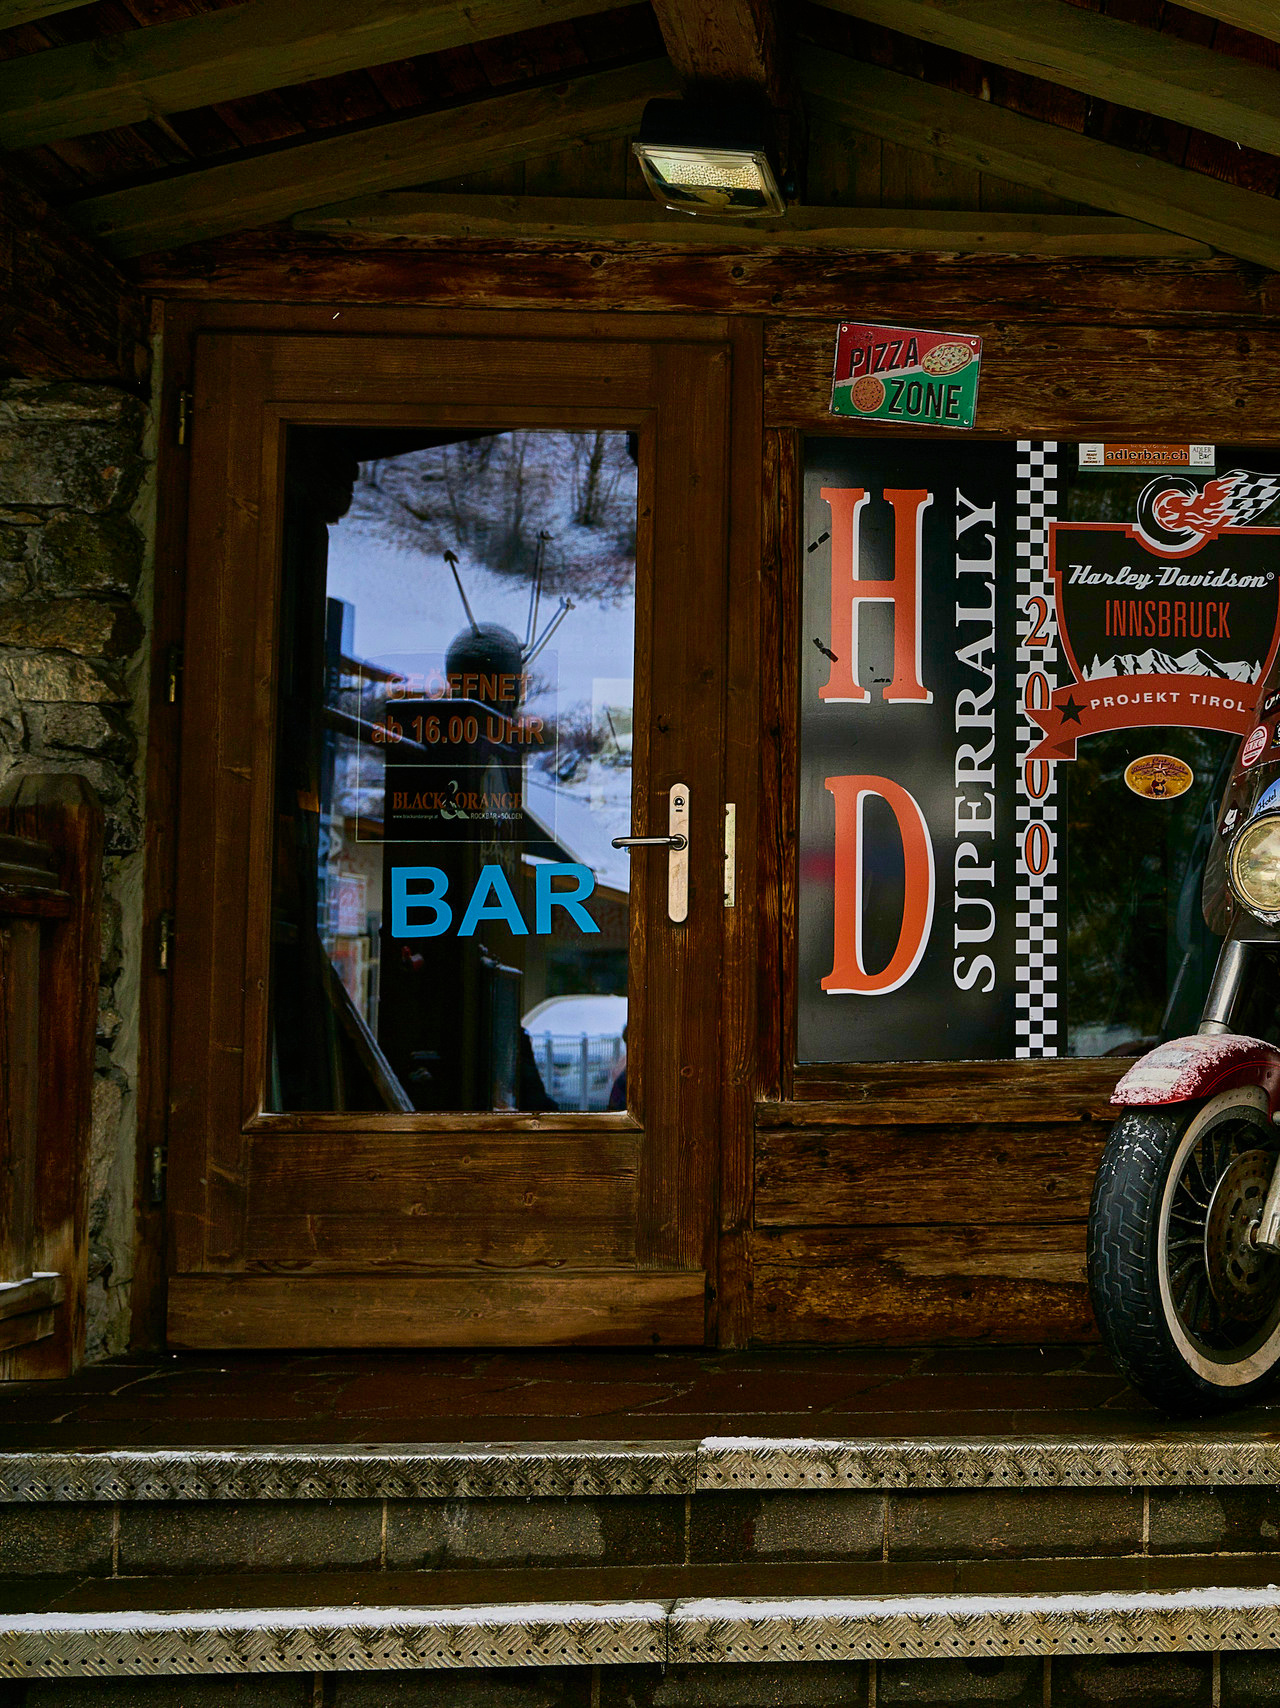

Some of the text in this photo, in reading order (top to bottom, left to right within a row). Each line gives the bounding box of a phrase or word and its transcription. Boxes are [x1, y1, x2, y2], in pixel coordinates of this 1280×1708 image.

[849, 337, 921, 378] PIZZA
[888, 378, 963, 420] ZONE
[1106, 448, 1188, 461] adlerbar.ch
[1105, 599, 1231, 639] INNSBRUCK
[386, 669, 533, 701] GEÖFFNET
[1090, 691, 1181, 711] PROJEKT
[1189, 693, 1247, 713] TIROL
[371, 715, 545, 744] ab 16.00 UHR
[953, 486, 996, 993] SUPERRALLY
[393, 791, 446, 809] BLACK
[391, 862, 601, 938] BAR
